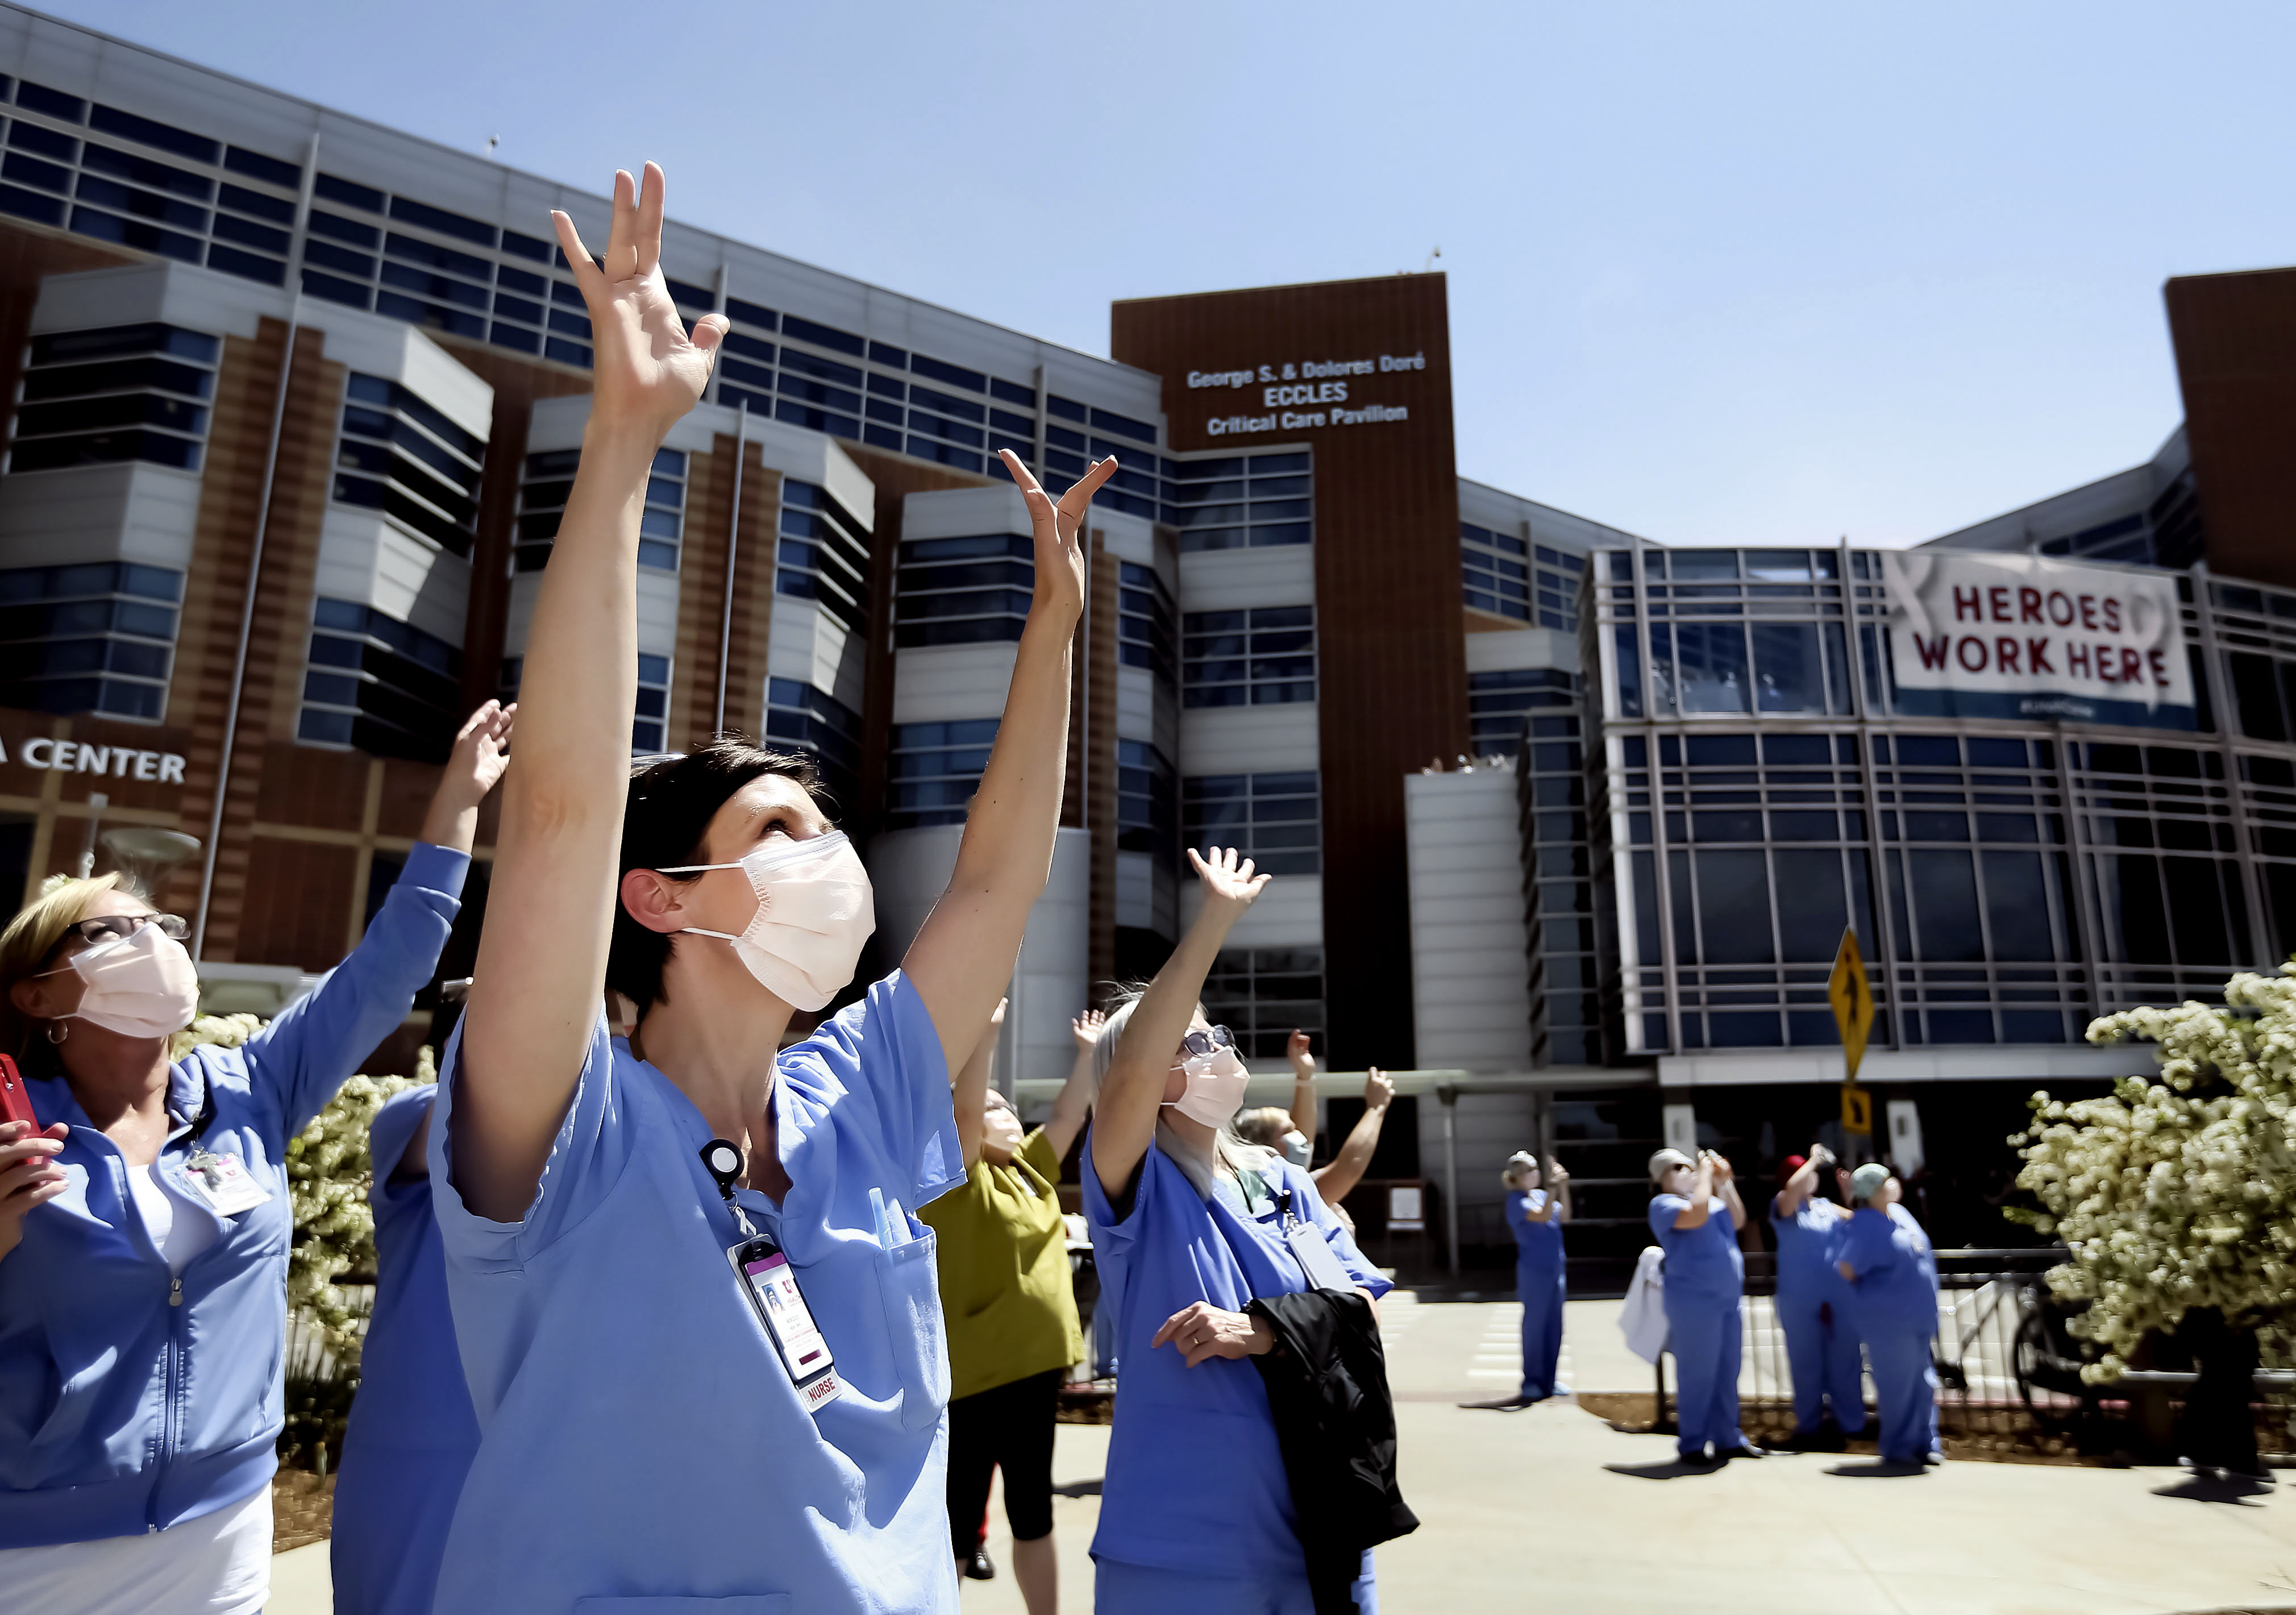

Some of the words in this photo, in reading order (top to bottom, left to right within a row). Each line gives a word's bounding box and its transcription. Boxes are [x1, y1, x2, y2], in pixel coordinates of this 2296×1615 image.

[1187, 370, 1254, 388] George
[1258, 364, 1278, 383] S.
[1282, 363, 1297, 380] &
[1302, 359, 1374, 379] Dolores
[1379, 351, 1425, 372] Doré
[1263, 382, 1349, 407] ECCLES
[1207, 413, 1276, 436] Critical
[1281, 411, 1326, 430] Care
[1330, 404, 1408, 426] Pavilion
[1953, 585, 2122, 633] HEROES
[1912, 632, 2054, 675] WORK
[2066, 641, 2170, 686] HERE
[22, 738, 186, 784] CENTER
[808, 1376, 836, 1402] NURSE
